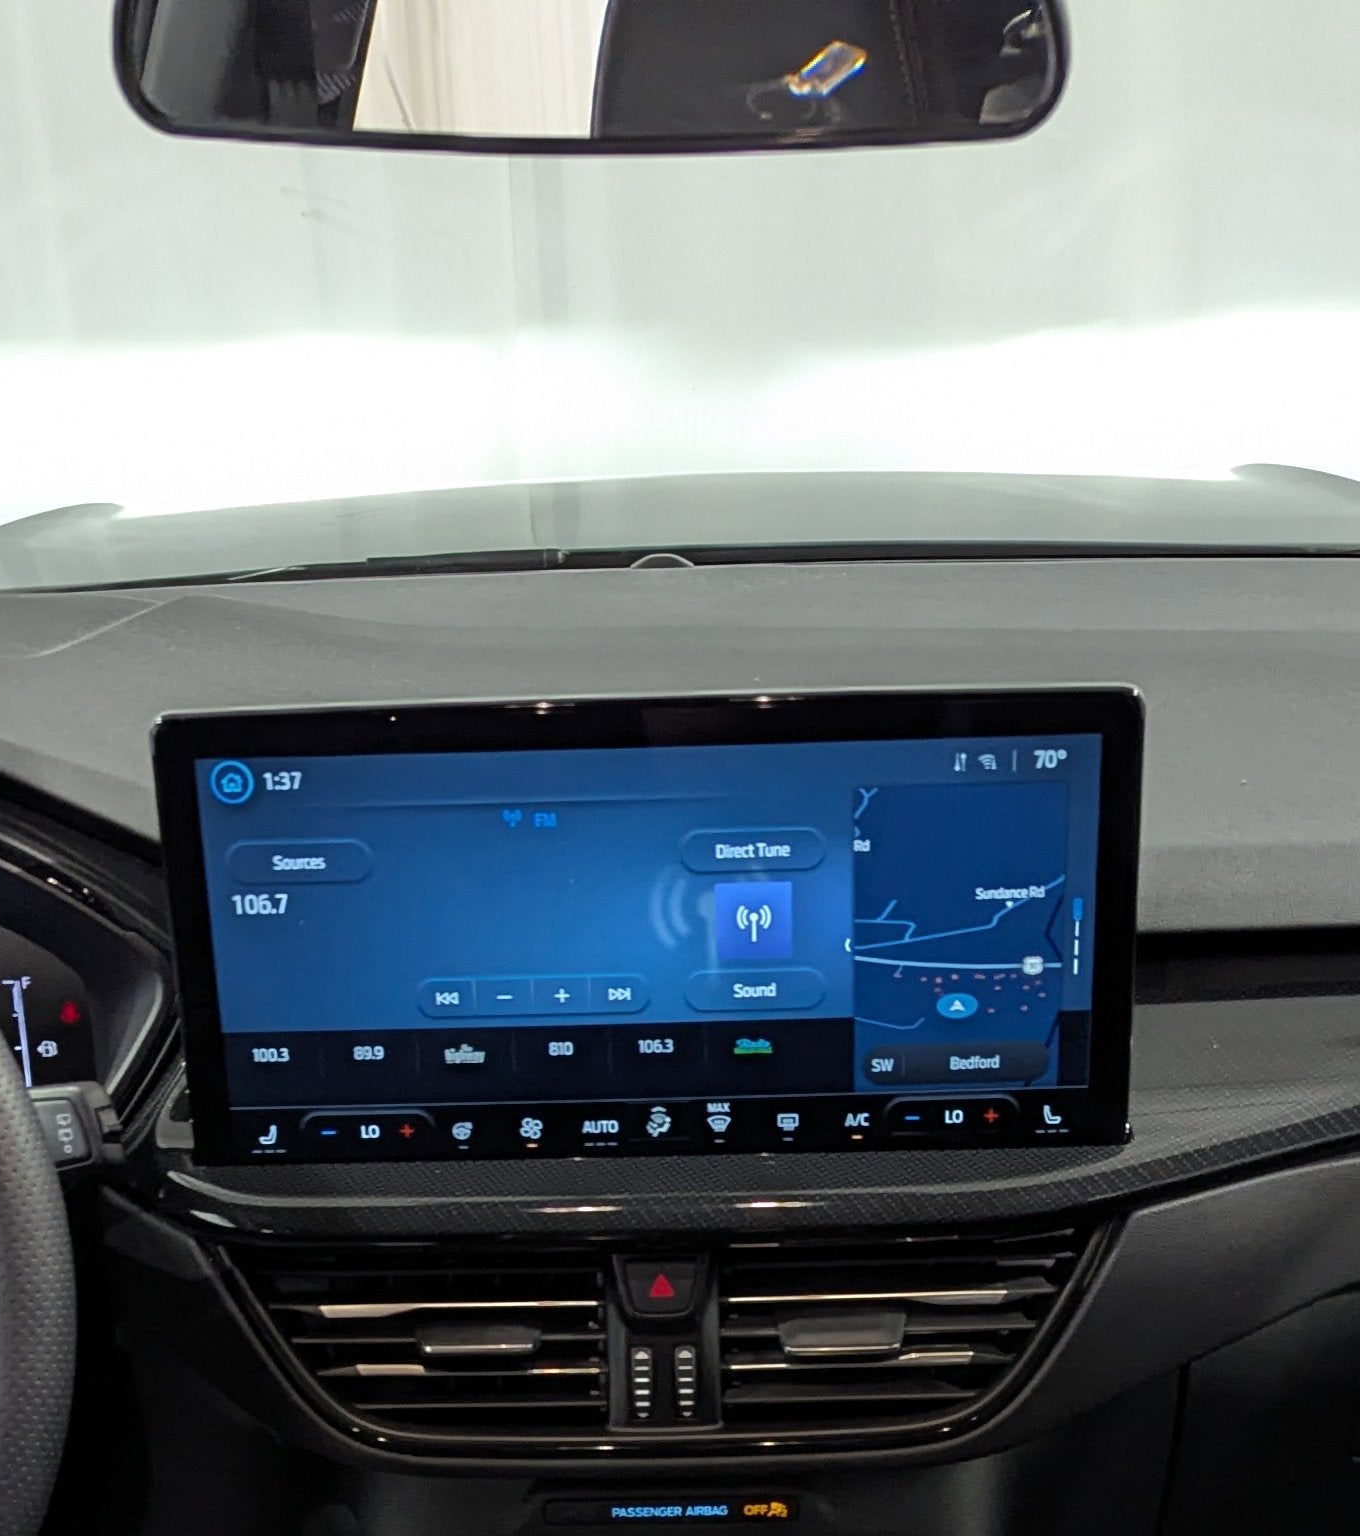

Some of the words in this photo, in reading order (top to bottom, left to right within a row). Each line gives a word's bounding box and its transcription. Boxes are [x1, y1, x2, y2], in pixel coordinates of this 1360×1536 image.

[262, 770, 302, 791] 1:37
[533, 811, 557, 828] FM
[715, 843, 755, 860] Direct
[756, 842, 791, 859] Tune
[271, 854, 327, 871] Sources
[975, 886, 1028, 900] Sundance
[1029, 885, 1046, 898] Rd
[231, 893, 289, 915] 106.7
[732, 983, 777, 999] Sound
[352, 1045, 386, 1061] 89.9
[548, 1041, 574, 1057] 810
[638, 1038, 674, 1054] 106.3
[251, 1046, 290, 1063] 100.3
[870, 1058, 894, 1073] SW
[949, 1055, 1001, 1071] Bedford
[706, 1102, 731, 1113] MAX
[844, 1112, 870, 1128] A/C
[944, 1110, 964, 1124] LO
[360, 1124, 381, 1139] LO
[581, 1120, 619, 1134] AUTO
[611, 1506, 683, 1518] PASSENGER
[685, 1505, 729, 1517] AIRBAG
[743, 1504, 768, 1516] OFF
